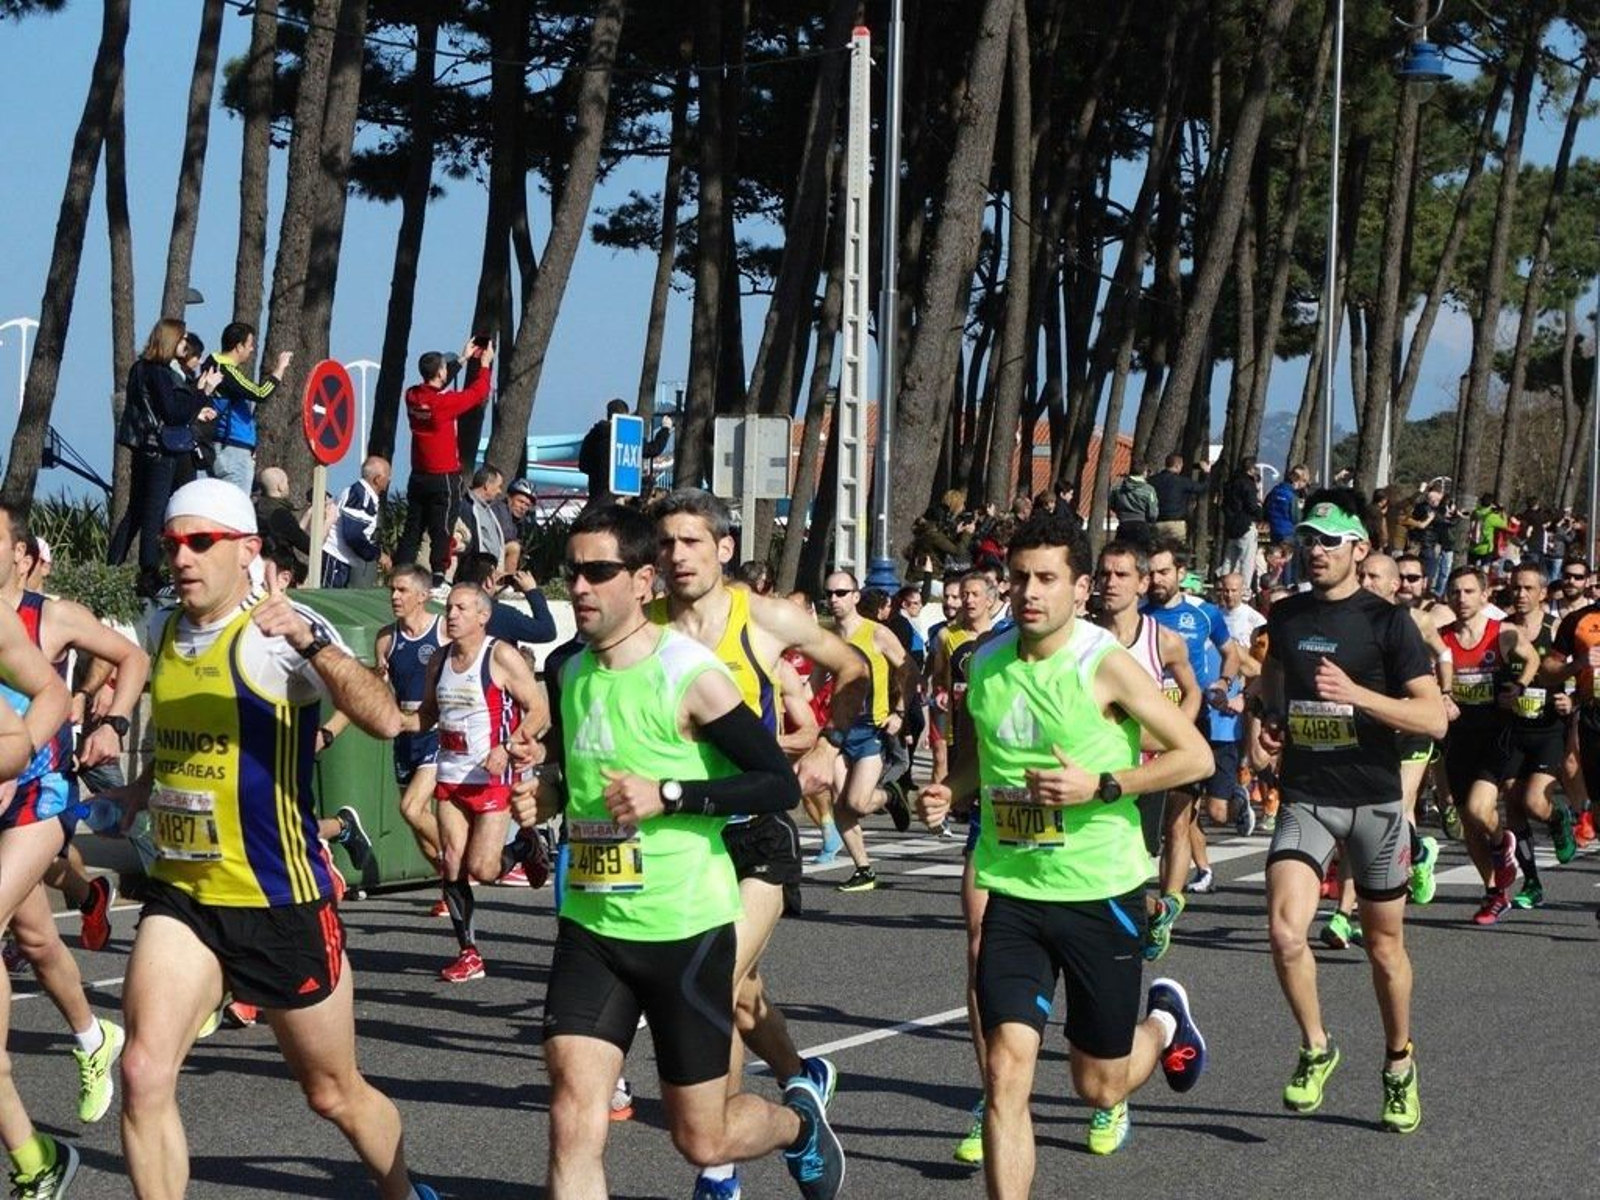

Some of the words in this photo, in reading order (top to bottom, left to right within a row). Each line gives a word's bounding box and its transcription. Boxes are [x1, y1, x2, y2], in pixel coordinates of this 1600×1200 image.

[617, 443, 642, 469] TAXI
[1303, 719, 1340, 739] 4193
[158, 812, 195, 844] 4187
[1008, 808, 1046, 834] 4170
[578, 846, 621, 875] 4169
